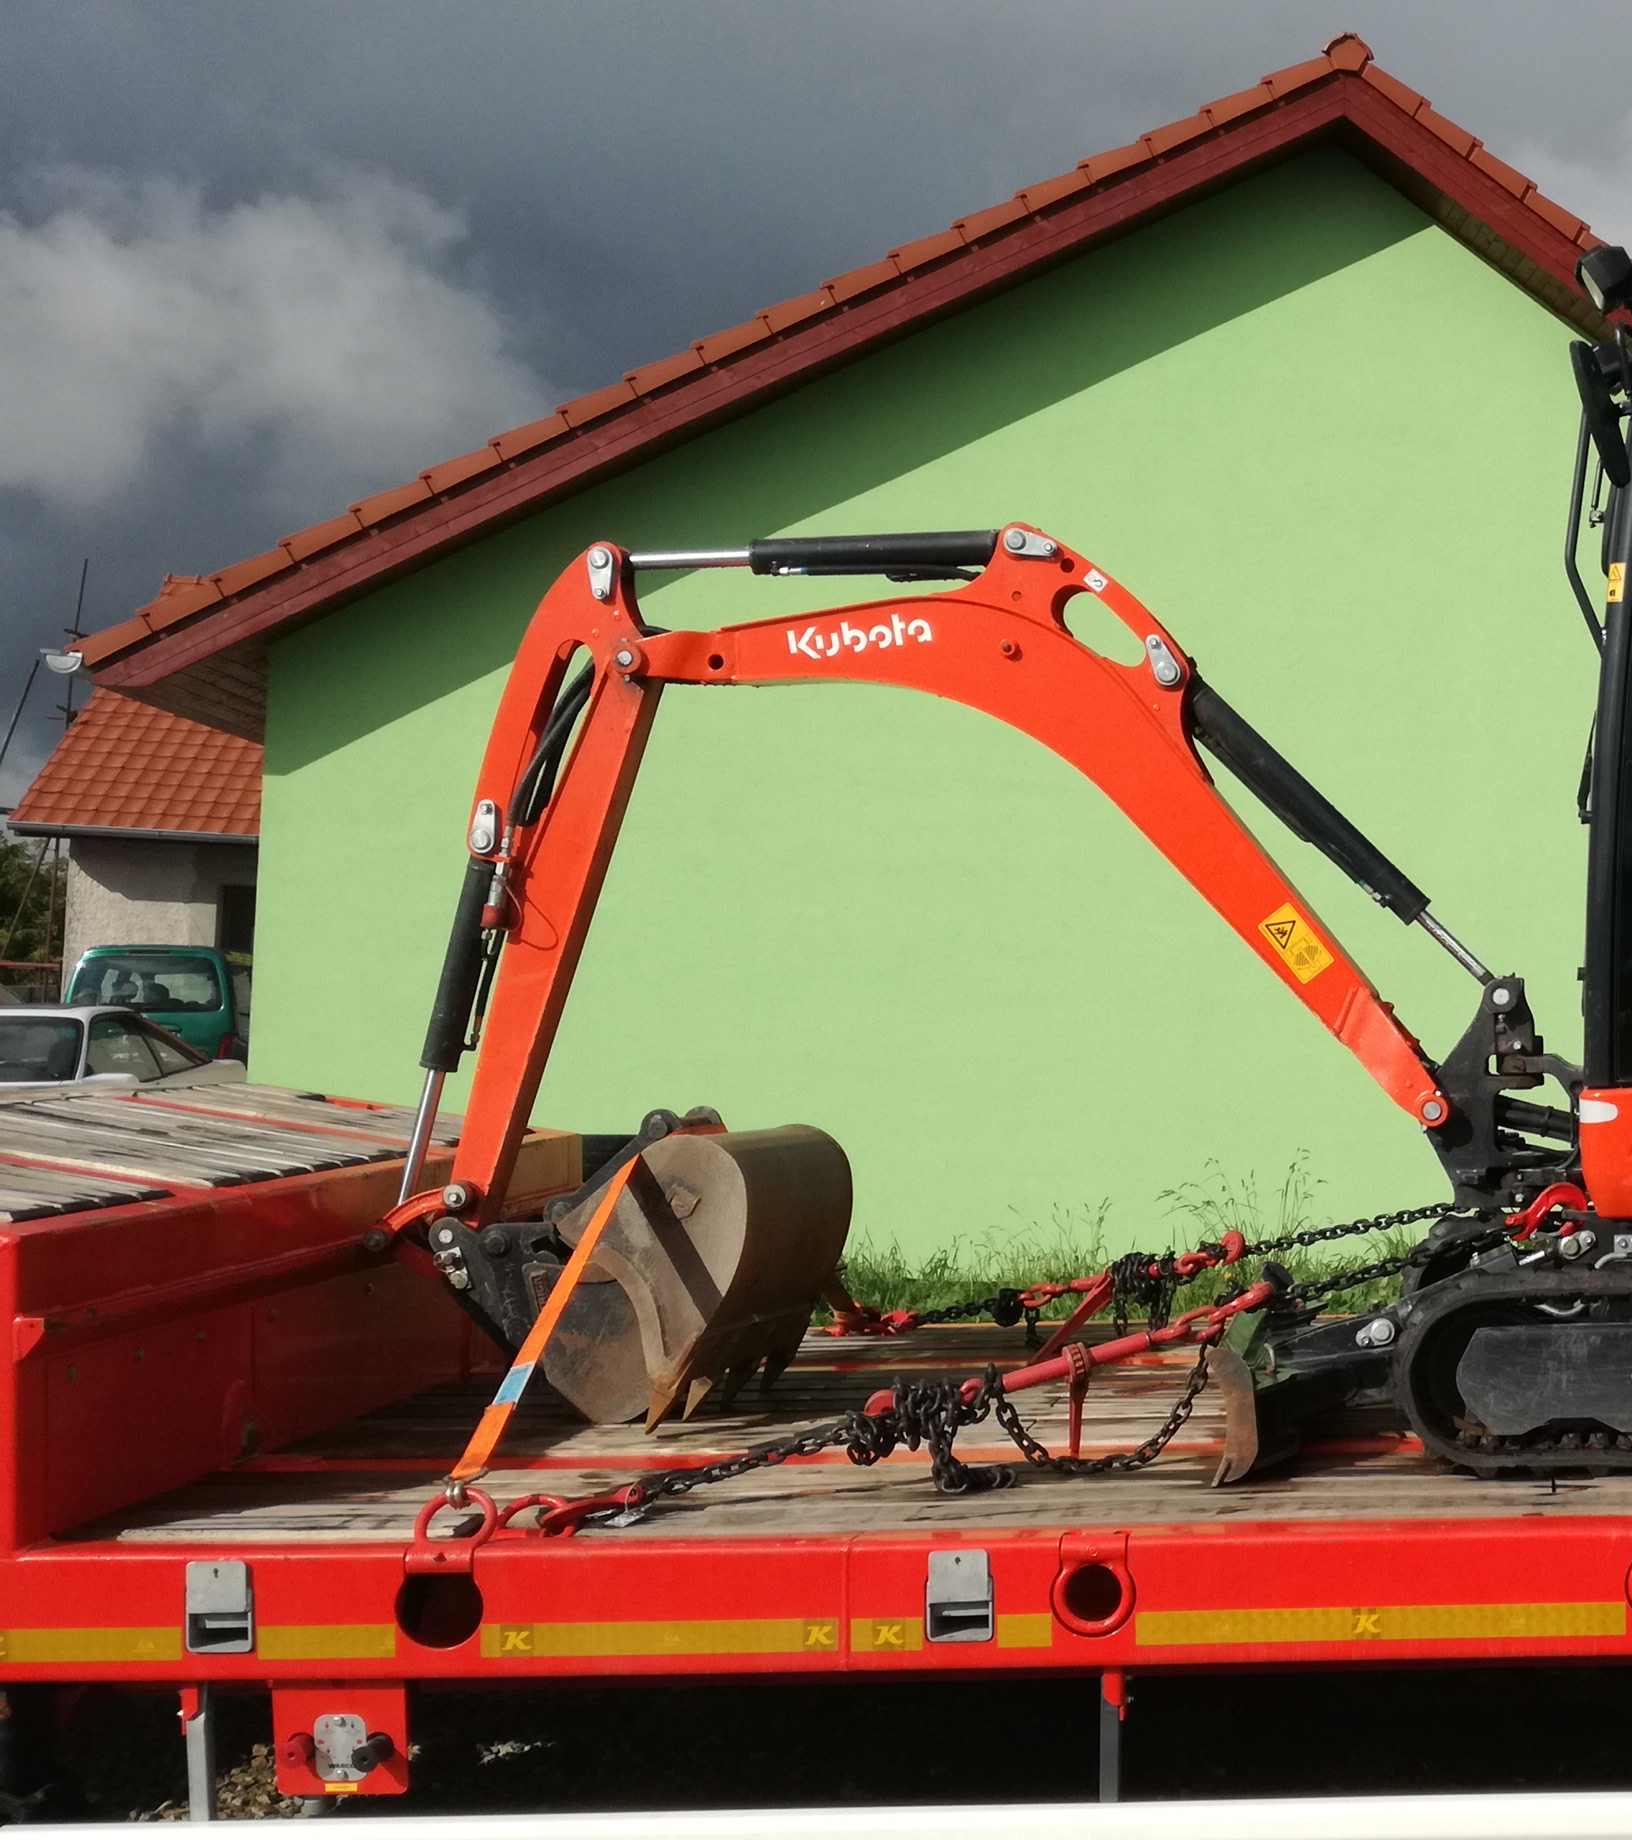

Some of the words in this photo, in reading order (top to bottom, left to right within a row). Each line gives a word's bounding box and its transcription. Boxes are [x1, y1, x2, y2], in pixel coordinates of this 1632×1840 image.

[786, 613, 933, 660] Kubota
[1353, 1614, 1382, 1633] K
[502, 1631, 532, 1651] K
[804, 1625, 834, 1645] K
[873, 1625, 904, 1645] K
